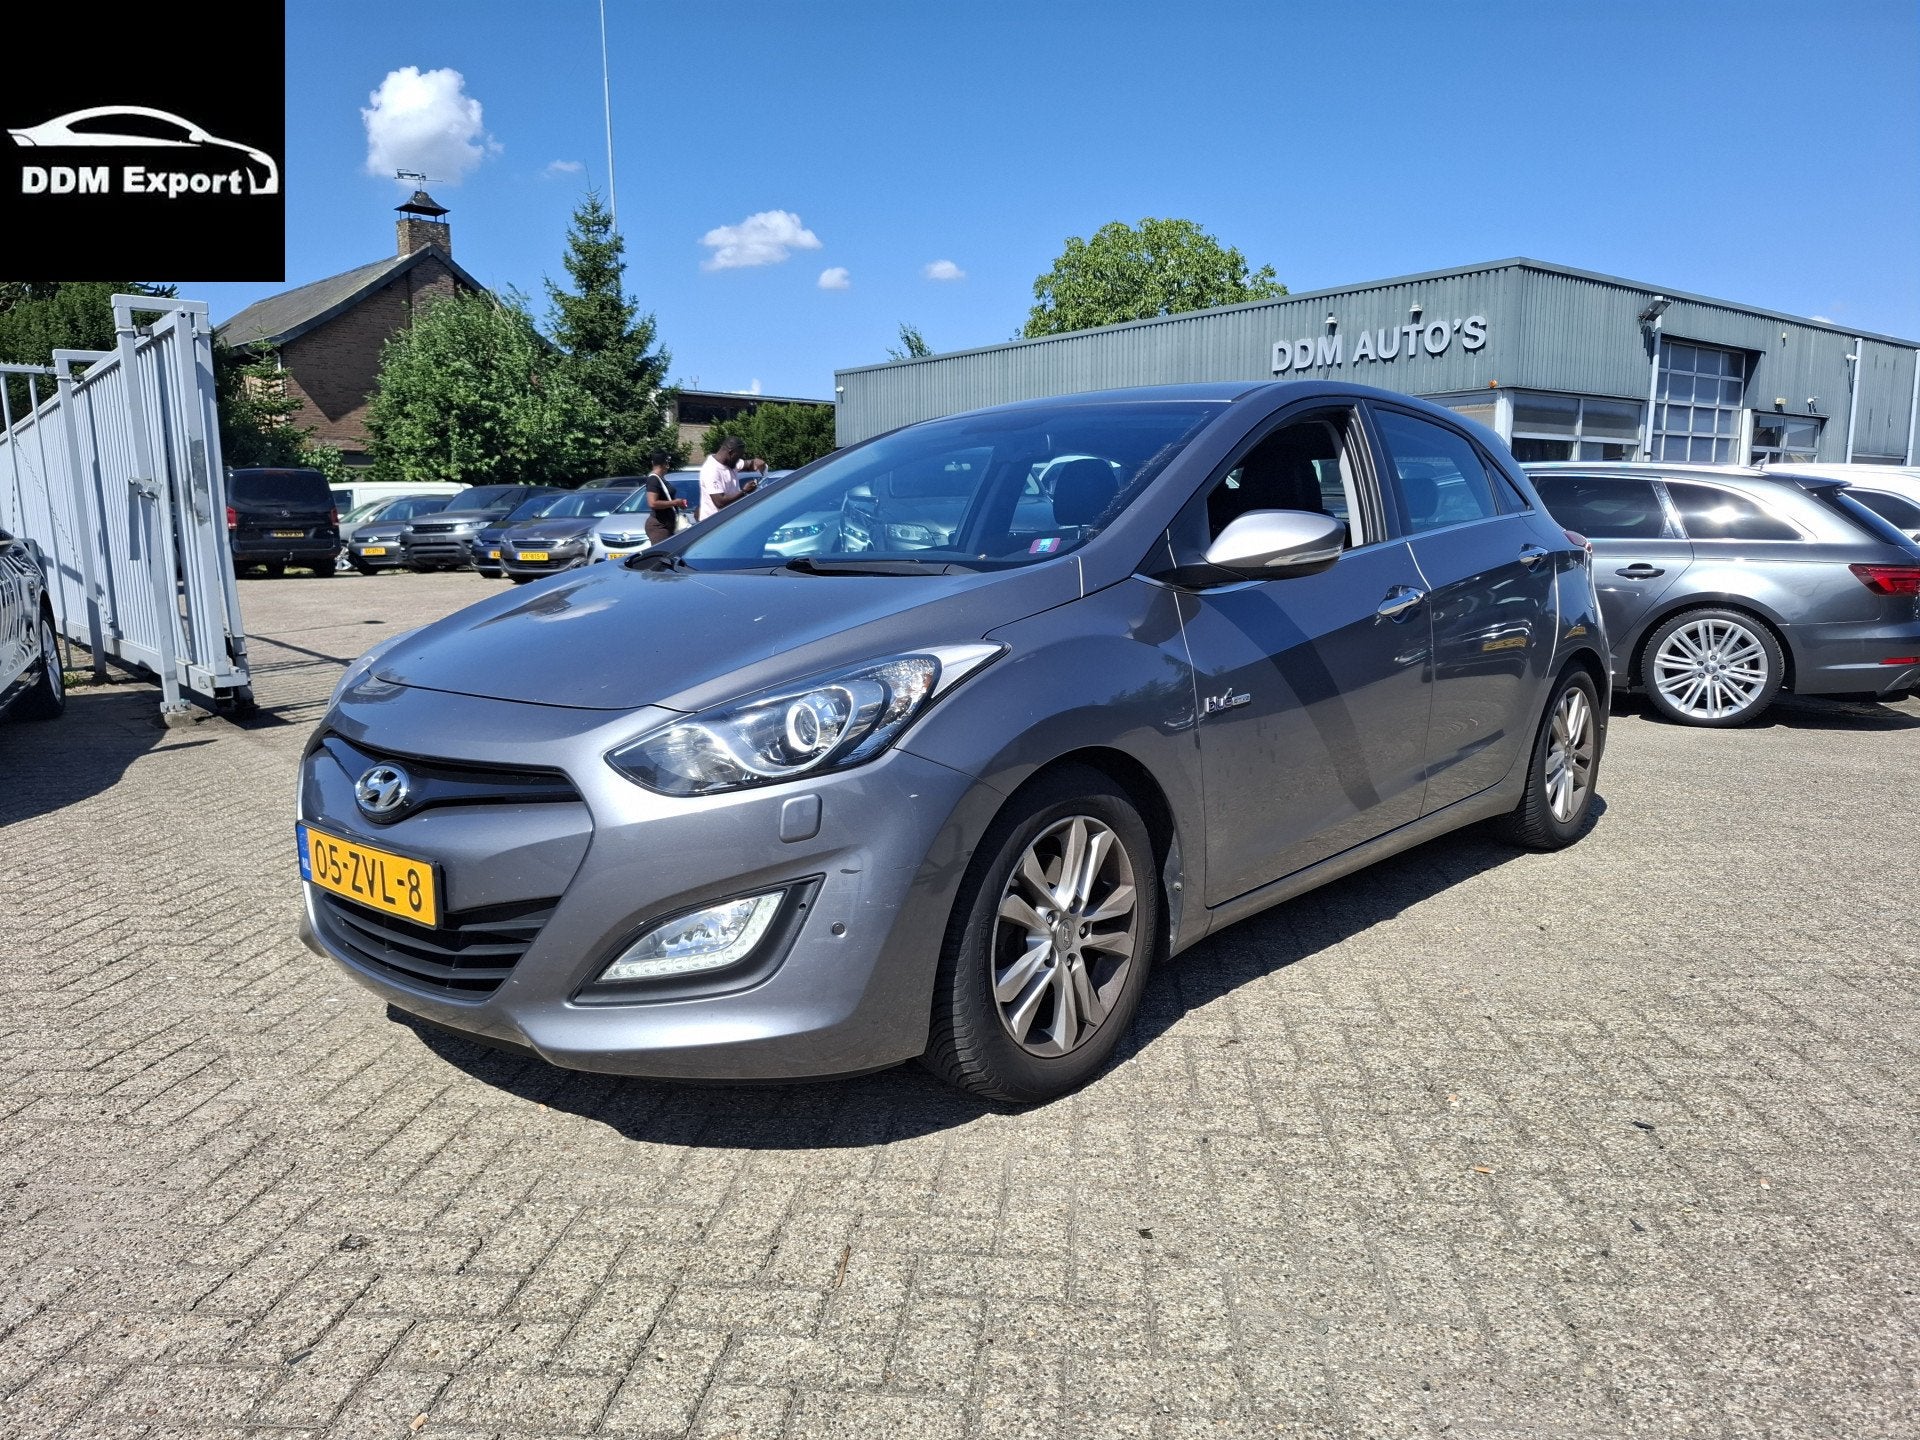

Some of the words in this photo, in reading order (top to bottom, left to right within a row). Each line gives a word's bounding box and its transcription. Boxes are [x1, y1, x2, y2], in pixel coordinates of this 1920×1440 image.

[1272, 334, 1343, 373] DDM
[1352, 315, 1488, 363] AUTO'S
[314, 838, 423, 913] 05-ZVL-8
